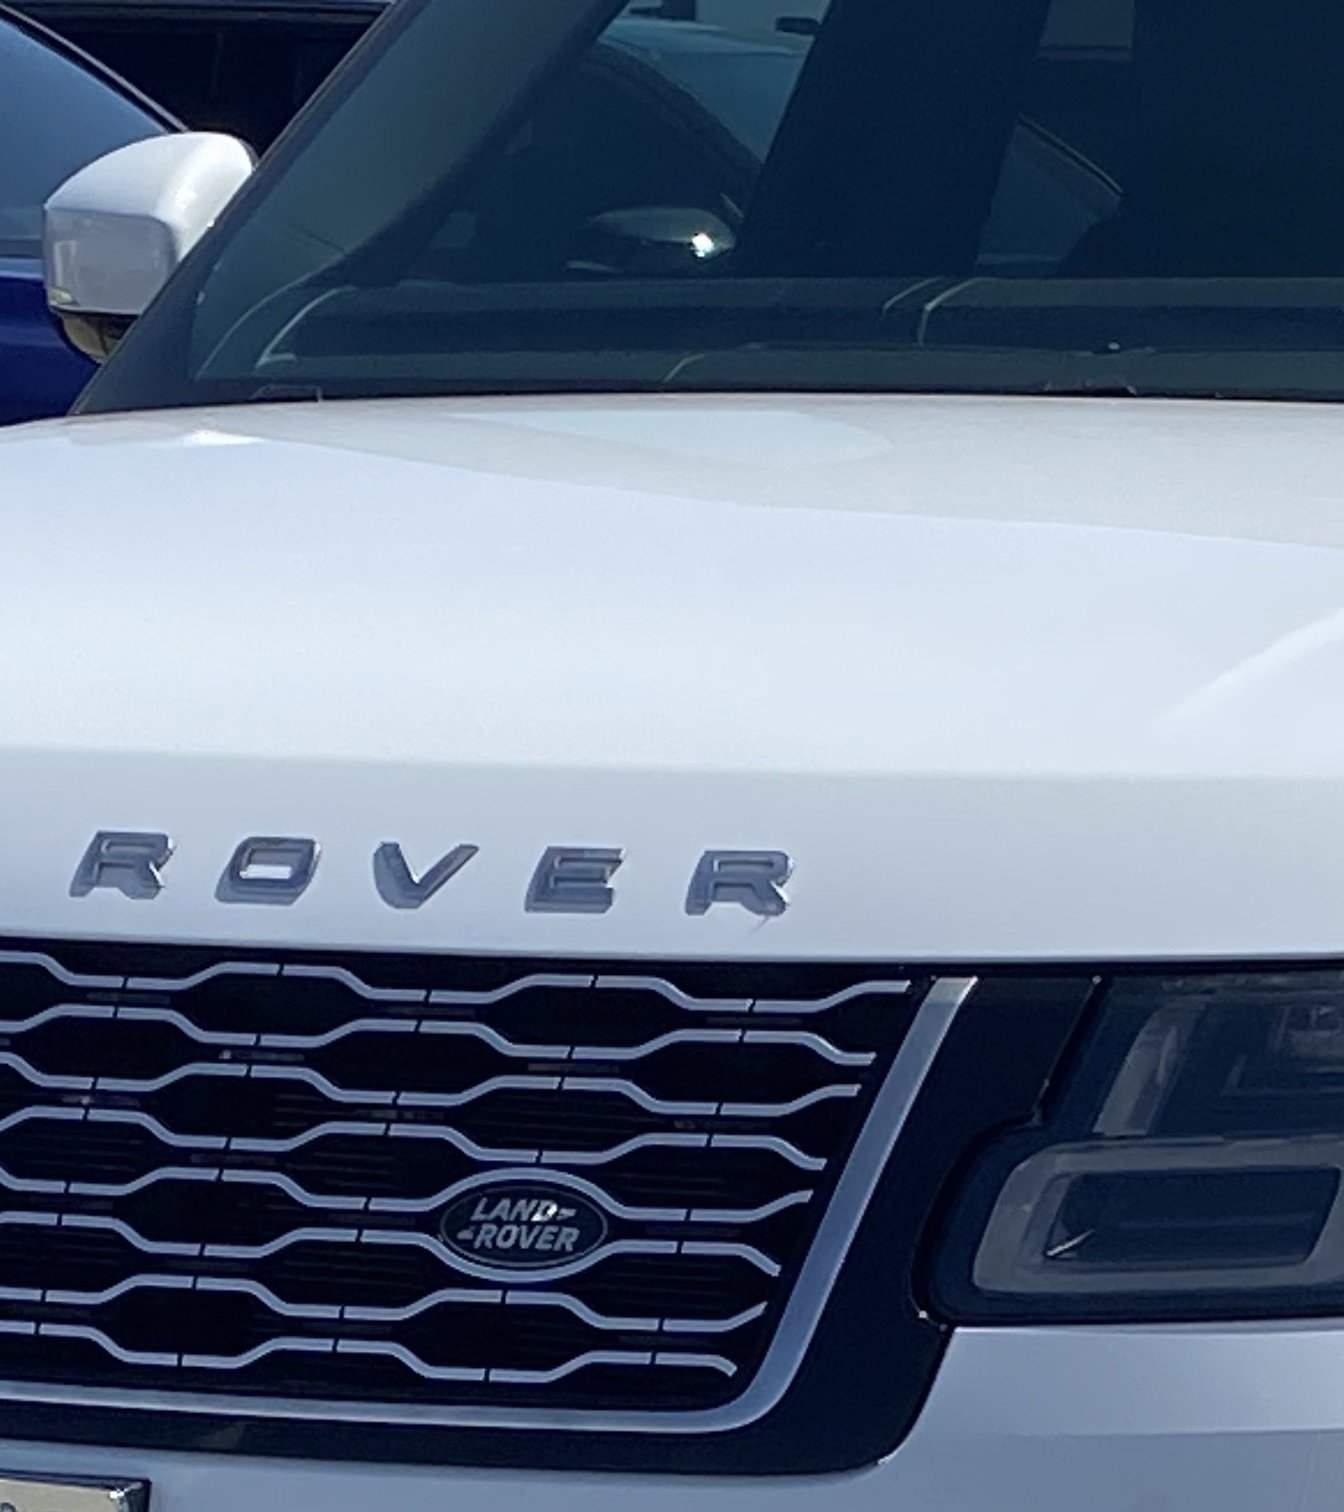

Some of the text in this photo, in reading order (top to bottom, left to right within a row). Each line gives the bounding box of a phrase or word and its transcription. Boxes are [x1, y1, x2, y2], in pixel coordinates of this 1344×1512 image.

[70, 829, 795, 915] ROVER
[470, 1197, 558, 1222] LAND
[474, 1222, 580, 1252] ROVER
